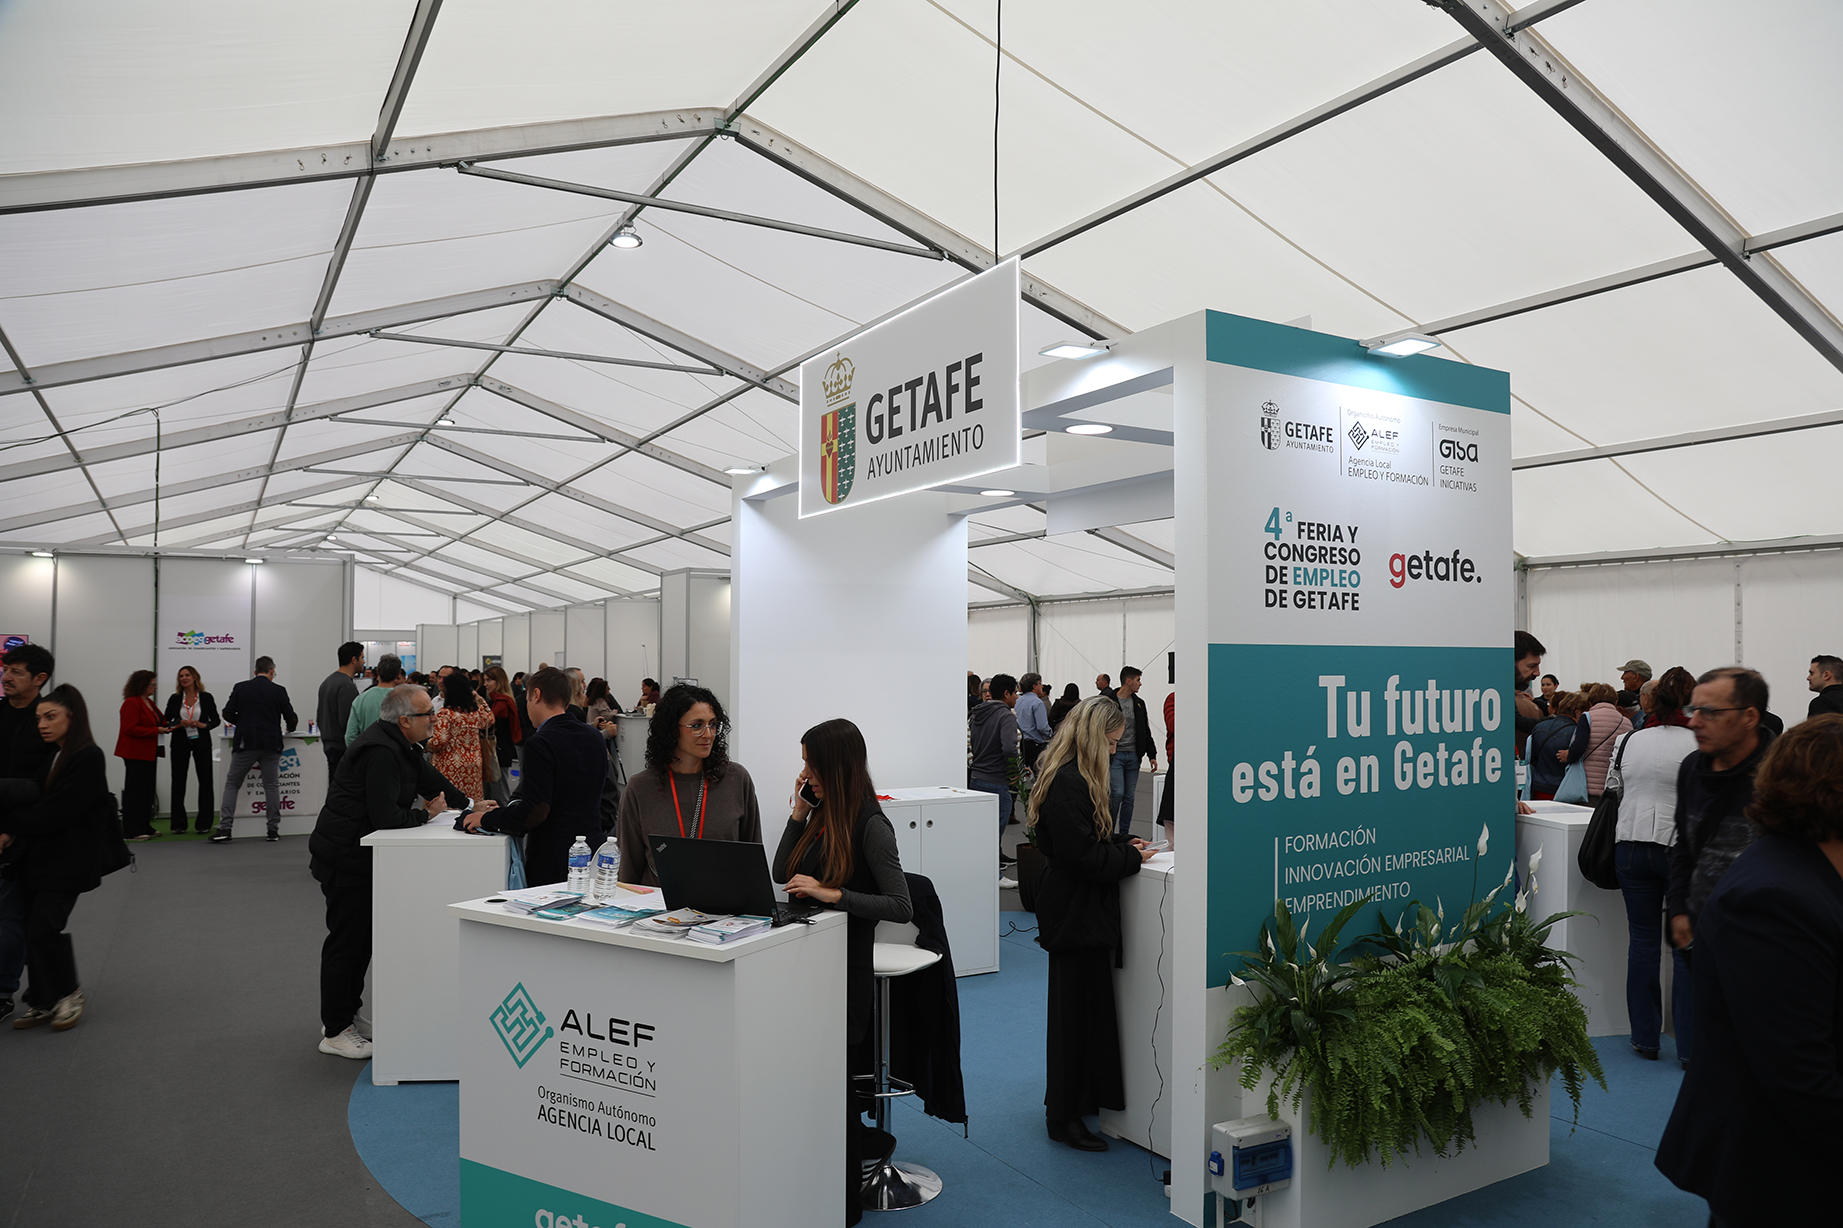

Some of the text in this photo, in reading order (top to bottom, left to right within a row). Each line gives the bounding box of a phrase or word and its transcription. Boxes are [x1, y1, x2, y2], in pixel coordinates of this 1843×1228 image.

[866, 352, 983, 444] GETAFE
[1285, 421, 1333, 443] GETAFE
[1371, 429, 1399, 440] ALEF
[1439, 423, 1479, 437] Empresa Municipal
[867, 424, 984, 480] AYUNTAMIENTO
[1286, 440, 1334, 453] AYUNTAMIENTO
[1348, 456, 1391, 469] Agencia Local
[1440, 465, 1464, 477] GETAFE
[1348, 467, 1429, 486] EMPLEO Y FORMACIÓN
[1440, 480, 1477, 492] INICIATIVAS
[1298, 521, 1344, 543] FERIA
[1348, 526, 1358, 543] Y
[1264, 542, 1361, 566] CONGRESO
[1266, 564, 1361, 589] DE EMPLEO
[1389, 550, 1481, 589] getafe.
[1265, 588, 1360, 611] DE GETAFE
[204, 633, 234, 645] getafe
[1318, 674, 1501, 738] Tu futuro
[258, 772, 300, 780] AACIÓN
[1232, 736, 1502, 804] está en Getafe
[252, 796, 295, 813] gefe
[1285, 825, 1376, 853] FORMACIÓN
[1285, 846, 1470, 885] INNOVACIÓN EMPRESARIAL
[1285, 882, 1411, 915] EMPRENDIMIENTO
[560, 1009, 656, 1048] ALEF
[560, 1042, 656, 1073] EMPLEO Y
[560, 1058, 656, 1092] FORMACIÓN
[538, 1084, 656, 1128] Organismo Autónomo
[538, 1104, 656, 1152] AGENCIA LOCAL
